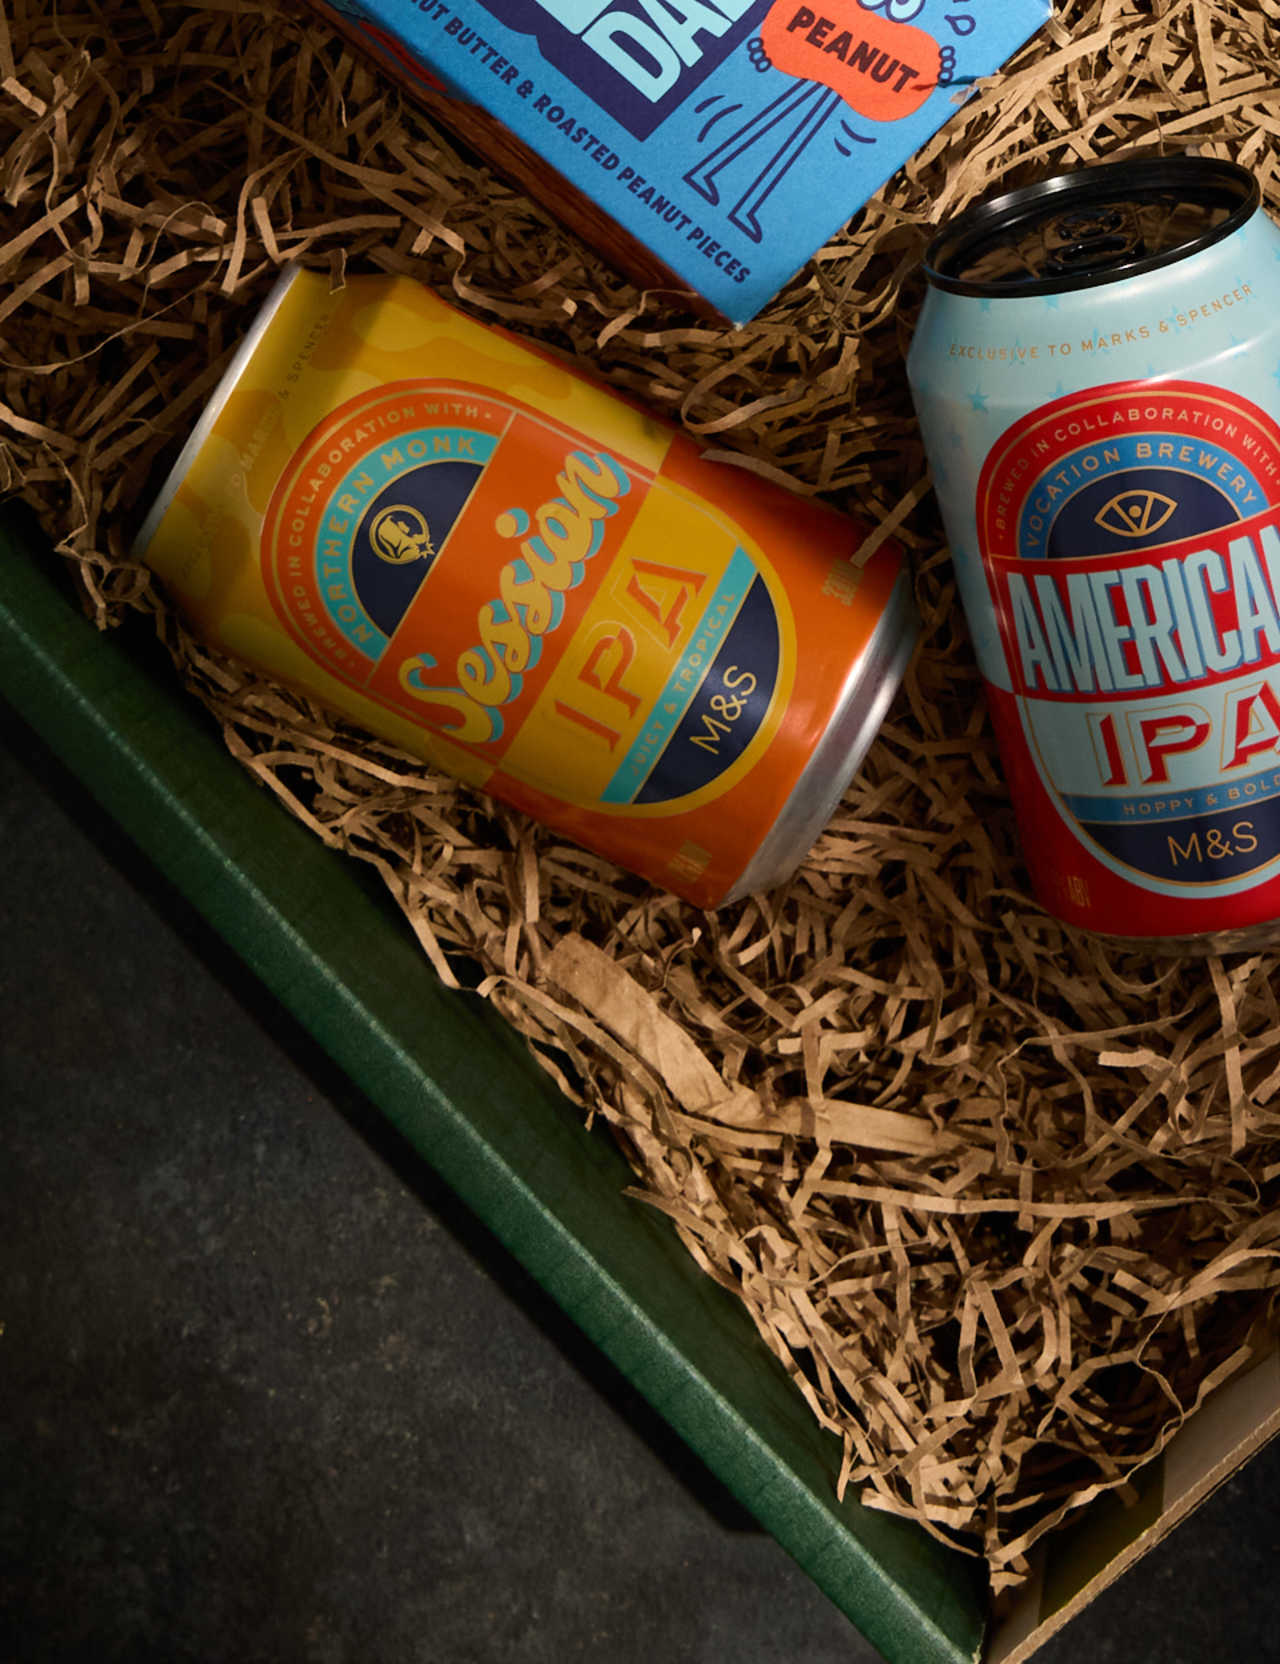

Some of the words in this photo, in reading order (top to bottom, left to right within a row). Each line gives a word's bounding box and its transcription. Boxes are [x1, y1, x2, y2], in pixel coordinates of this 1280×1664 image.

[785, 5, 921, 93] PEANUT
[443, 17, 521, 90] BUTTER
[516, 79, 534, 99] &
[532, 94, 621, 172] ROASTED
[616, 166, 693, 241] PEANUT
[687, 227, 752, 284] PIECES
[948, 342, 1039, 361] EXCLUSIVE
[1047, 343, 1072, 357] TO
[1081, 325, 1151, 353] MARKS
[1158, 320, 1169, 334] &
[1175, 282, 1254, 328] SPENCER
[422, 401, 479, 419] WITH
[1032, 439, 1050, 459] IN
[1054, 407, 1239, 443] COLLABORATION
[1241, 433, 1278, 479] WITH
[289, 406, 416, 548] COLLABORATION
[1026, 447, 1121, 549] VOCATION
[1136, 441, 1258, 505] BREWERY
[287, 555, 301, 577] IN
[322, 472, 375, 644] NORTHERN
[380, 435, 477, 471] MONK
[398, 451, 628, 744] Session
[554, 557, 710, 754] IPA
[630, 722, 666, 777] JUICY
[664, 700, 677, 715] &
[673, 591, 737, 692] TROPICAL
[688, 664, 758, 756] M&S
[1122, 797, 1196, 817] HOPPY
[1205, 792, 1218, 806] &
[1167, 820, 1259, 867] M&S
